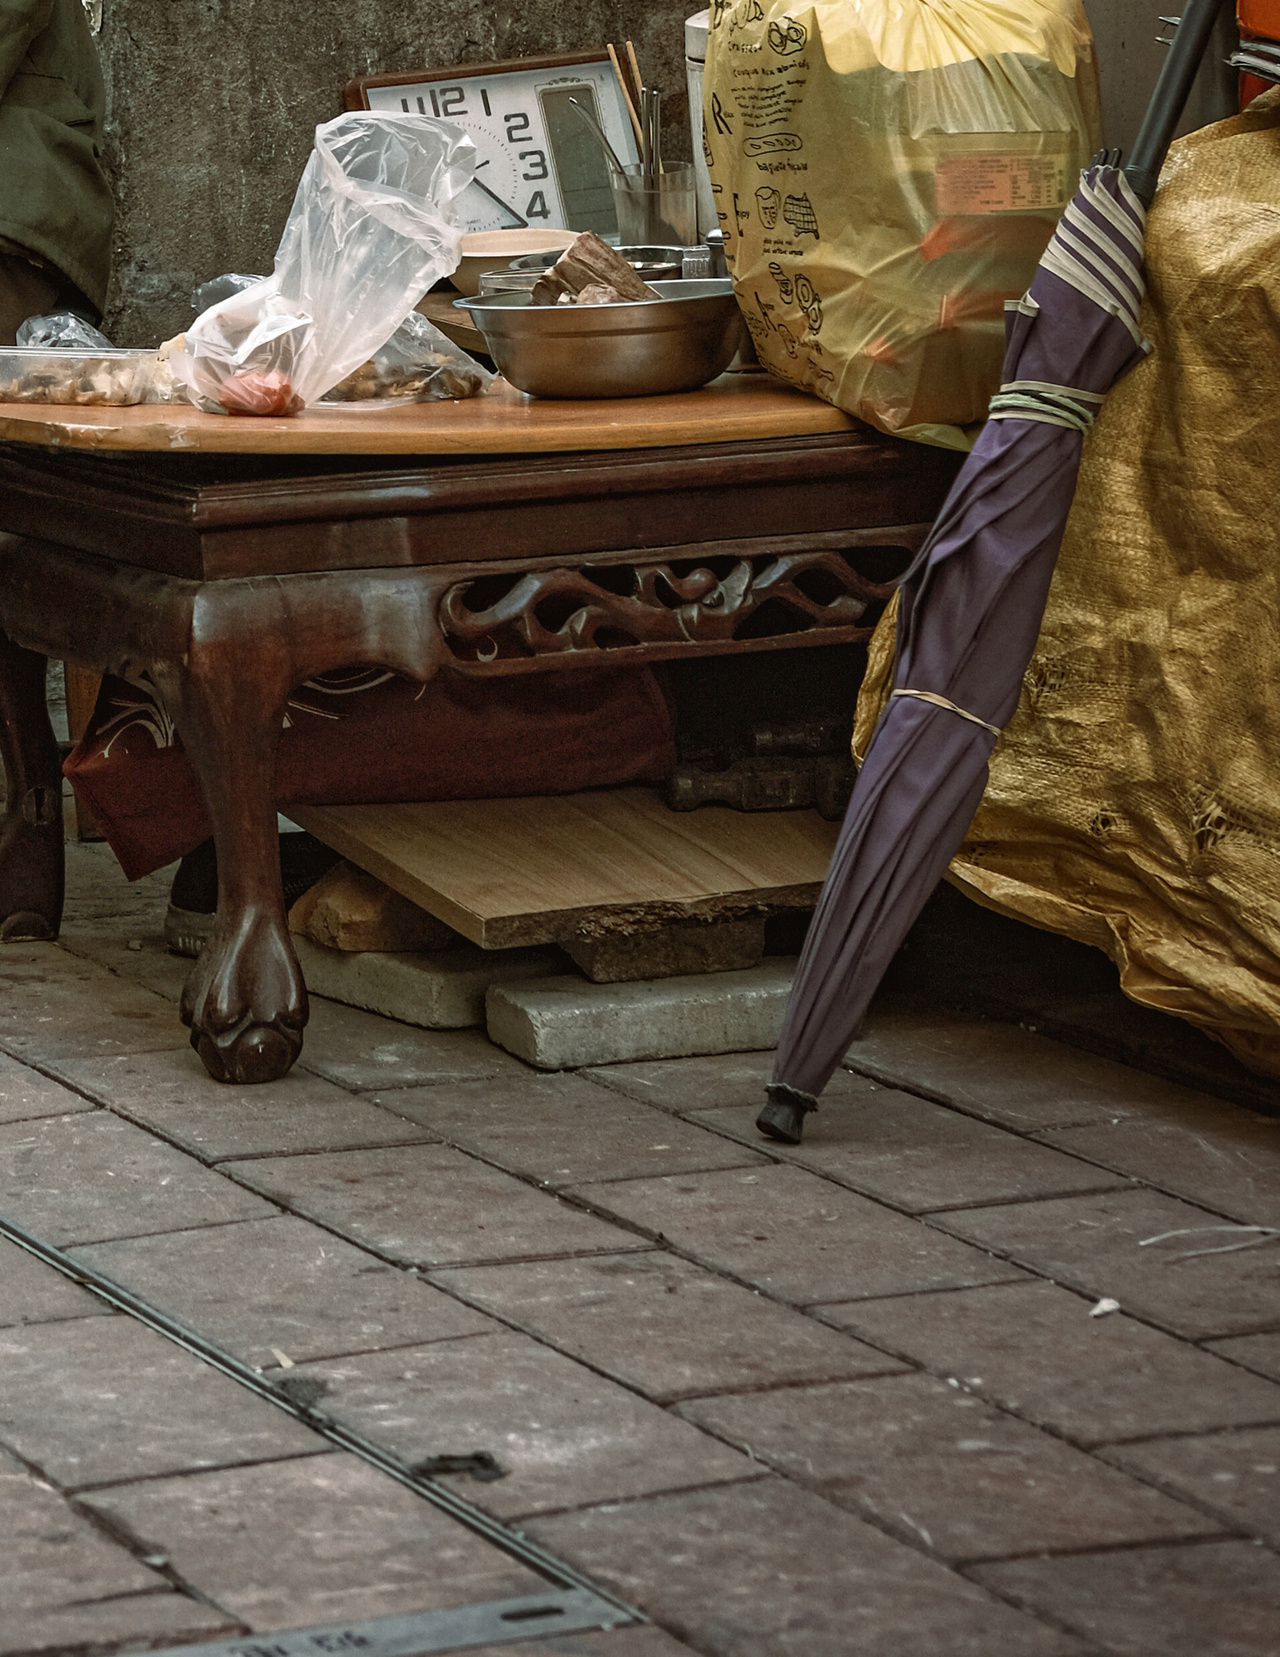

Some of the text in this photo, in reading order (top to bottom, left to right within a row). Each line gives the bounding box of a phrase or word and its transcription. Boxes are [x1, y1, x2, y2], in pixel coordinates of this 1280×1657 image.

[429, 86, 469, 118] 12
[503, 112, 533, 144] 2
[518, 149, 550, 182] 3
[525, 190, 551, 220] 4
